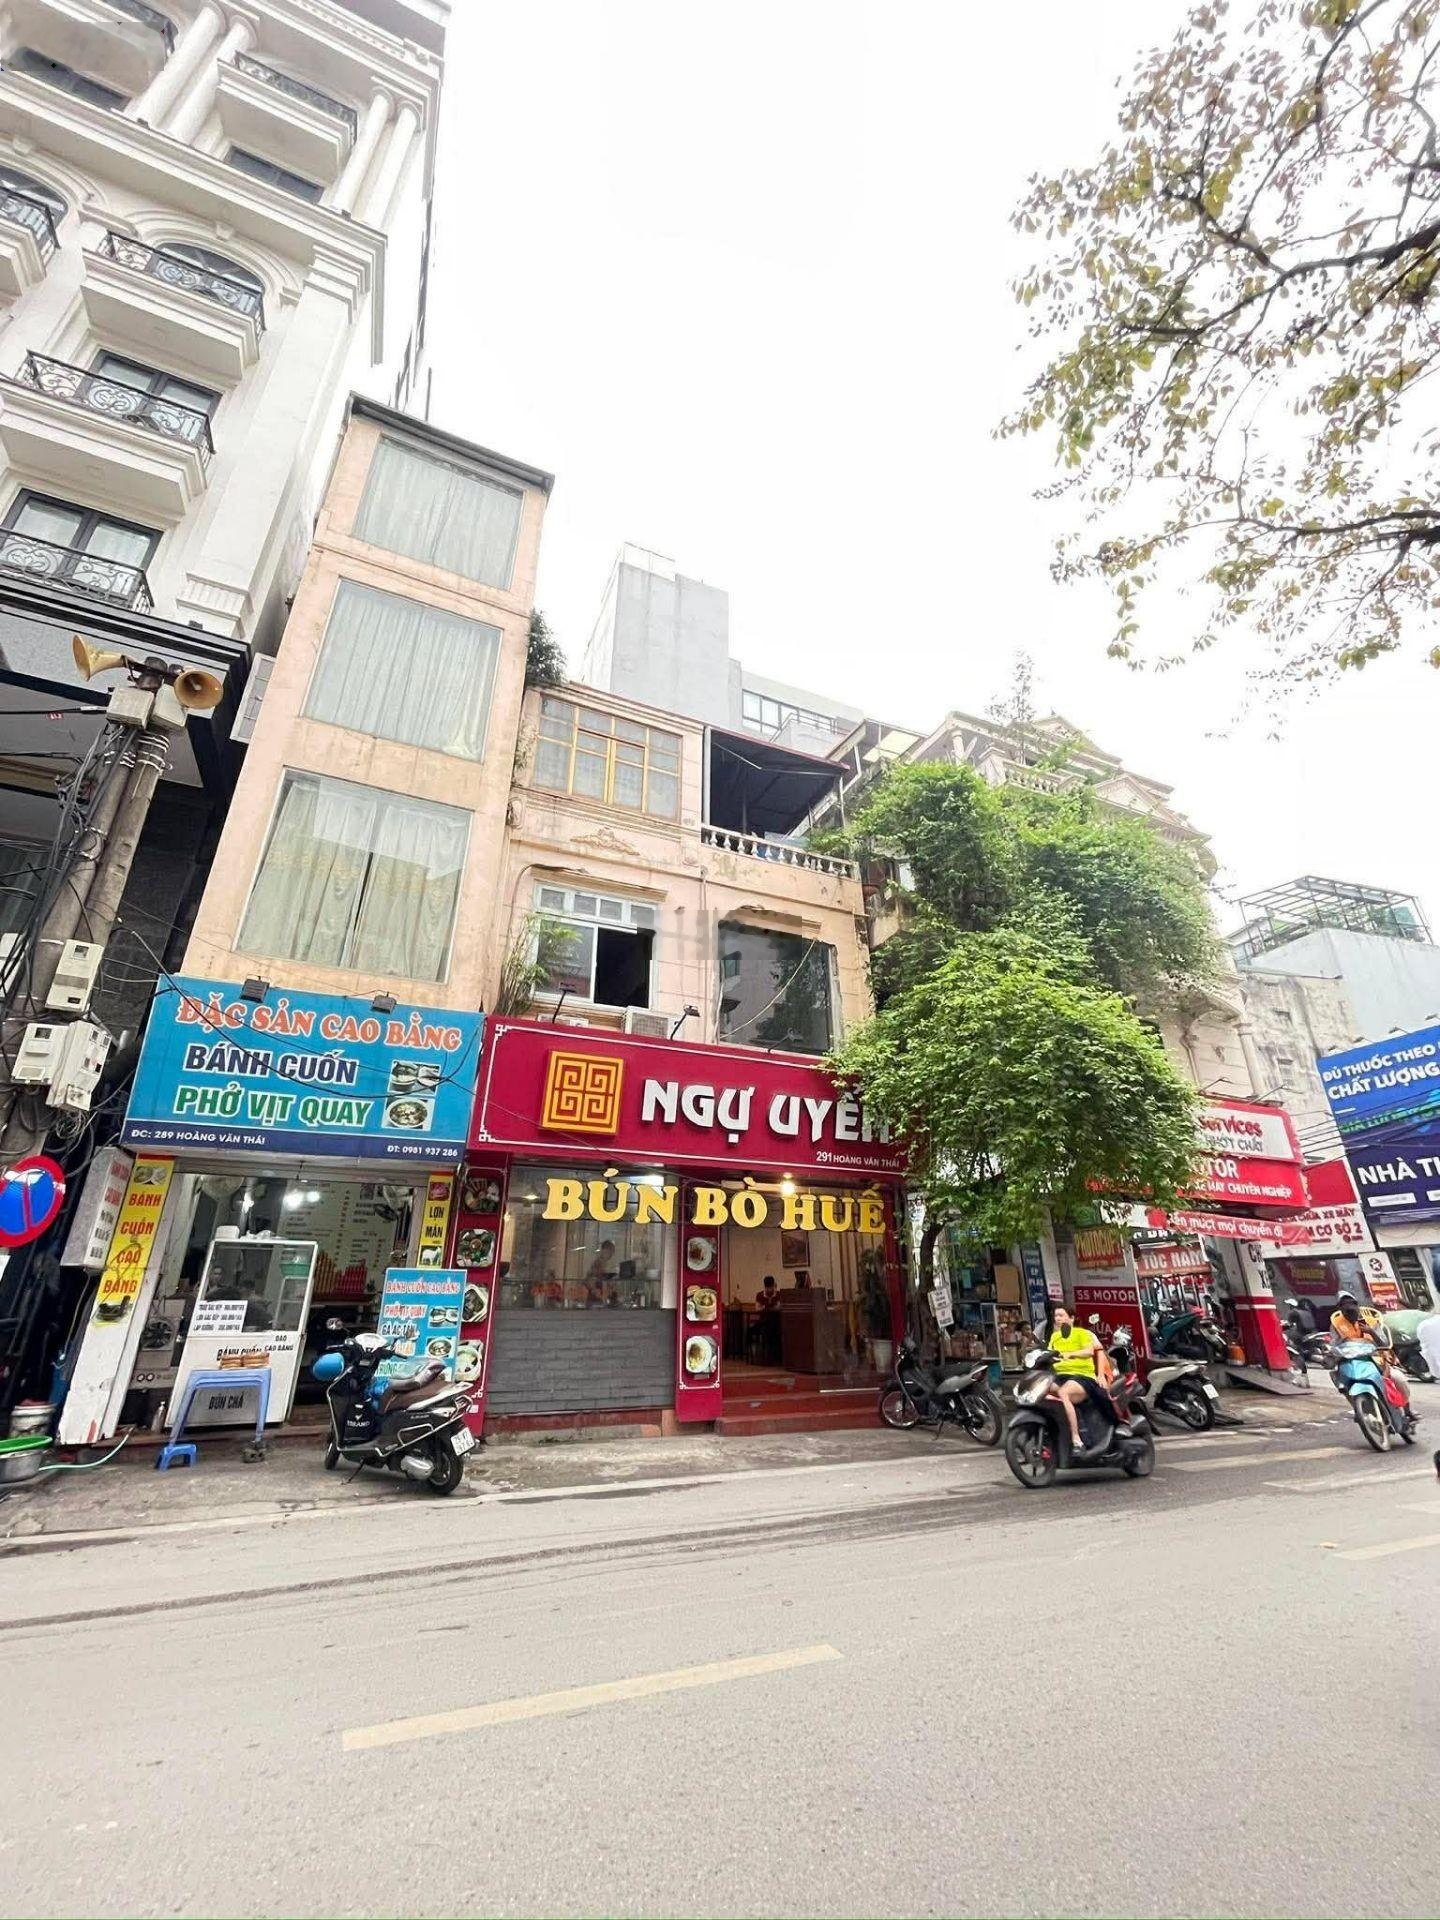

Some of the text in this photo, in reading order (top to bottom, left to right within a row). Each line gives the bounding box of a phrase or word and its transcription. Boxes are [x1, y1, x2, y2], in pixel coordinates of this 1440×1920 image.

[176, 991, 462, 1052] ĐẶC SẢN CAO BẰNG
[183, 1041, 358, 1085] BÁNH CUỐN
[1323, 1043, 1436, 1083] ĐỦ THUỐC THEO
[1328, 1061, 1440, 1100] CHẤT LƯỢNG
[174, 1082, 374, 1128] PHỞ VỊT QUAY
[641, 1079, 754, 1144] NGỰ
[154, 1131, 174, 1139] 289
[176, 1130, 216, 1141] HOÀNG
[219, 1132, 240, 1143] VĂN
[424, 1147, 440, 1156] 937
[440, 1148, 458, 1157] 286
[816, 1151, 832, 1162] 291
[833, 1155, 861, 1165] HOÀNG
[1357, 1157, 1417, 1185] NHÀ
[542, 1168, 886, 1234] BÚN BÒ HUẾ
[1218, 1219, 1236, 1234] mọi
[1354, 1222, 1362, 1233] 2
[116, 1250, 142, 1264] CAO
[1143, 1249, 1168, 1270] TÓC
[1092, 1290, 1136, 1302] MOTOR
